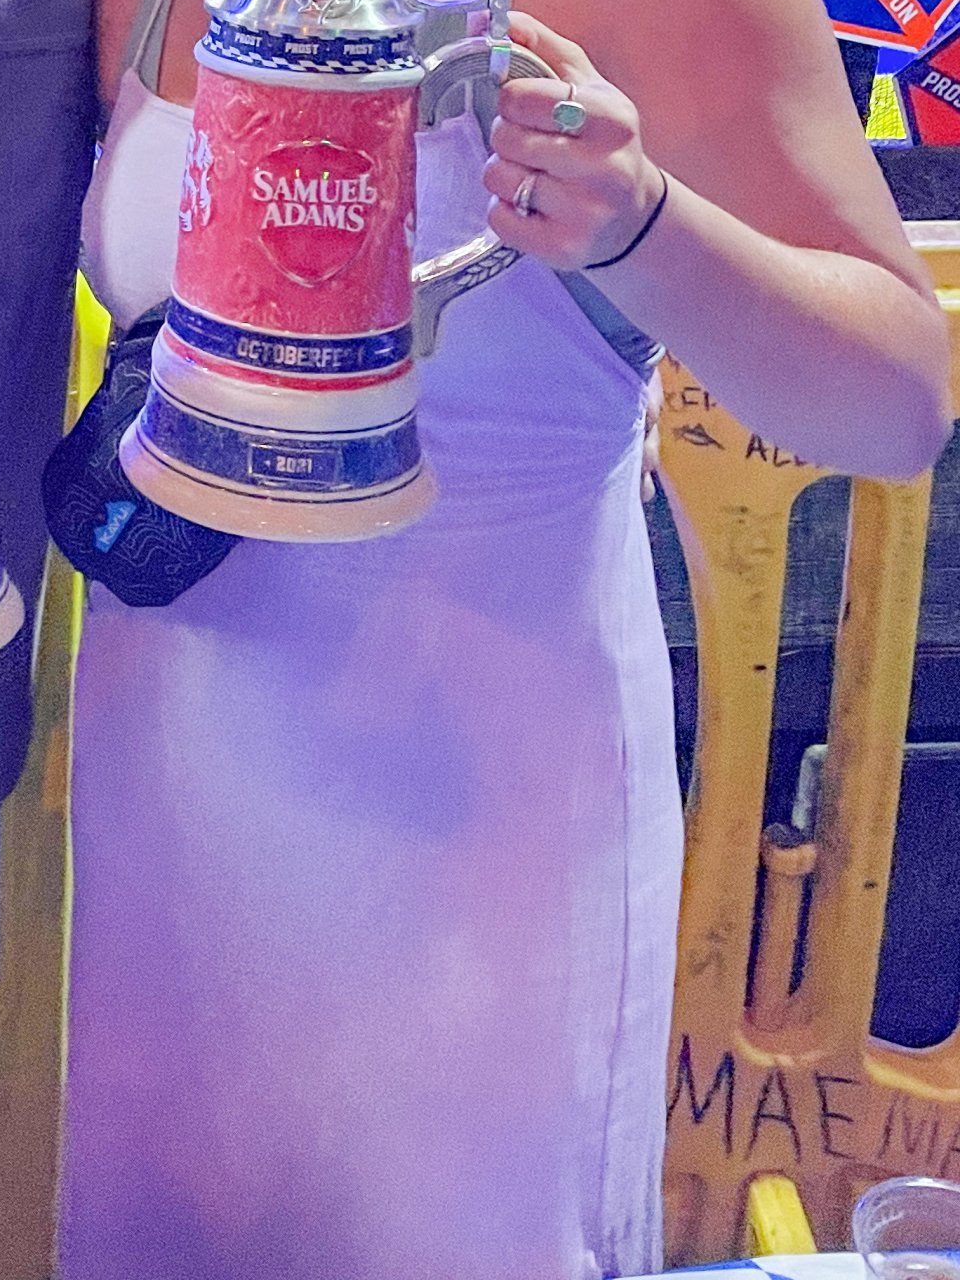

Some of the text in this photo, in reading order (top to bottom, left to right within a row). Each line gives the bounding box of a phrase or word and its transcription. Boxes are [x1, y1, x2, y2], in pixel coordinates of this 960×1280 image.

[285, 43, 318, 55] PROST
[252, 169, 376, 204] SAMUEL
[260, 203, 365, 232] ADAMS
